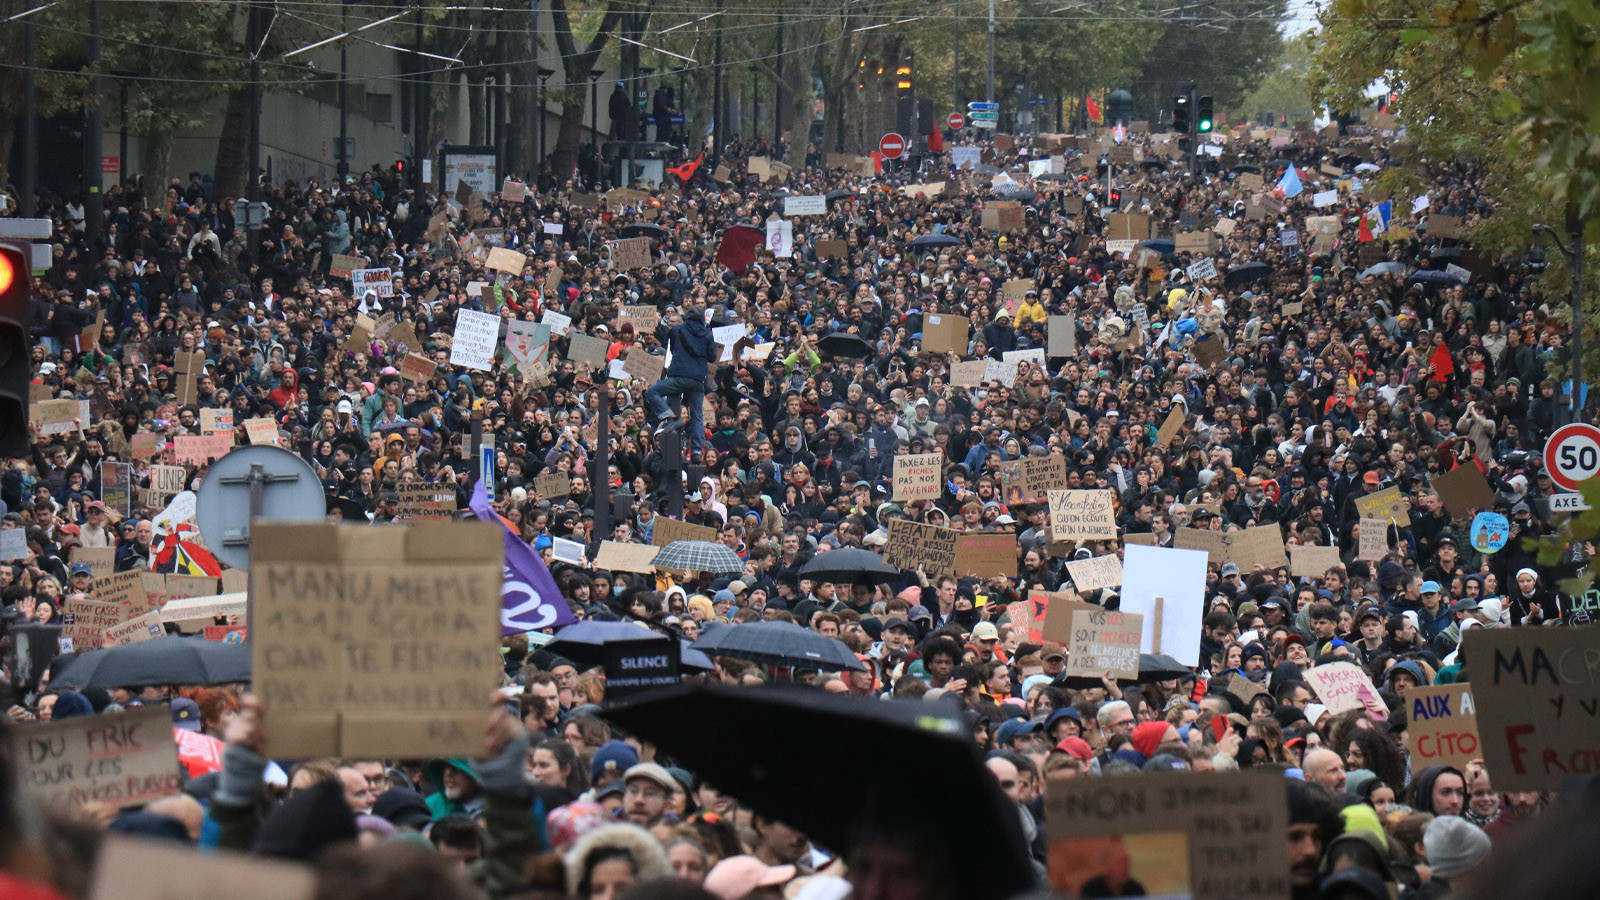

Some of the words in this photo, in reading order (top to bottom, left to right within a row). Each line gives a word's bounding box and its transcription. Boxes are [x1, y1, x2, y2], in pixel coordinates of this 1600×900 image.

[352, 272, 363, 283] LE
[898, 457, 925, 469] TAXEZ
[928, 457, 940, 466] LES
[1560, 445, 1597, 471] 50
[908, 467, 934, 475] RICHES
[899, 477, 913, 485] PAS
[920, 475, 935, 483] NOS
[399, 484, 405, 492] 2
[902, 485, 939, 495] AVENIRS
[1555, 498, 1578, 508] AXE
[1056, 513, 1081, 523] QU'ON
[933, 527, 960, 543] NOUS
[1054, 525, 1076, 534] ENFIN
[1078, 525, 1087, 534] LA
[1088, 525, 1113, 535] JEUNESSE
[890, 533, 920, 546] PISSE
[923, 540, 955, 552] DESSUS
[95, 577, 111, 590] MA
[114, 573, 140, 585] FRANCE
[95, 605, 120, 617] CASSE
[76, 615, 91, 626] NOS
[1089, 611, 1106, 625] VOS
[65, 626, 75, 636] LA
[79, 626, 104, 638] POLICE
[113, 619, 149, 640] IENVENUE
[1075, 629, 1097, 642] SONT
[73, 636, 89, 647] NOS
[121, 636, 131, 645] EN
[1075, 644, 1088, 655] MA
[621, 656, 669, 670] SILENCE
[1073, 657, 1080, 668] A
[1081, 656, 1096, 668] DES
[1413, 693, 1452, 721] AUX
[1549, 694, 1564, 721] Y
[29, 735, 67, 765] DU
[87, 757, 123, 778] LES
